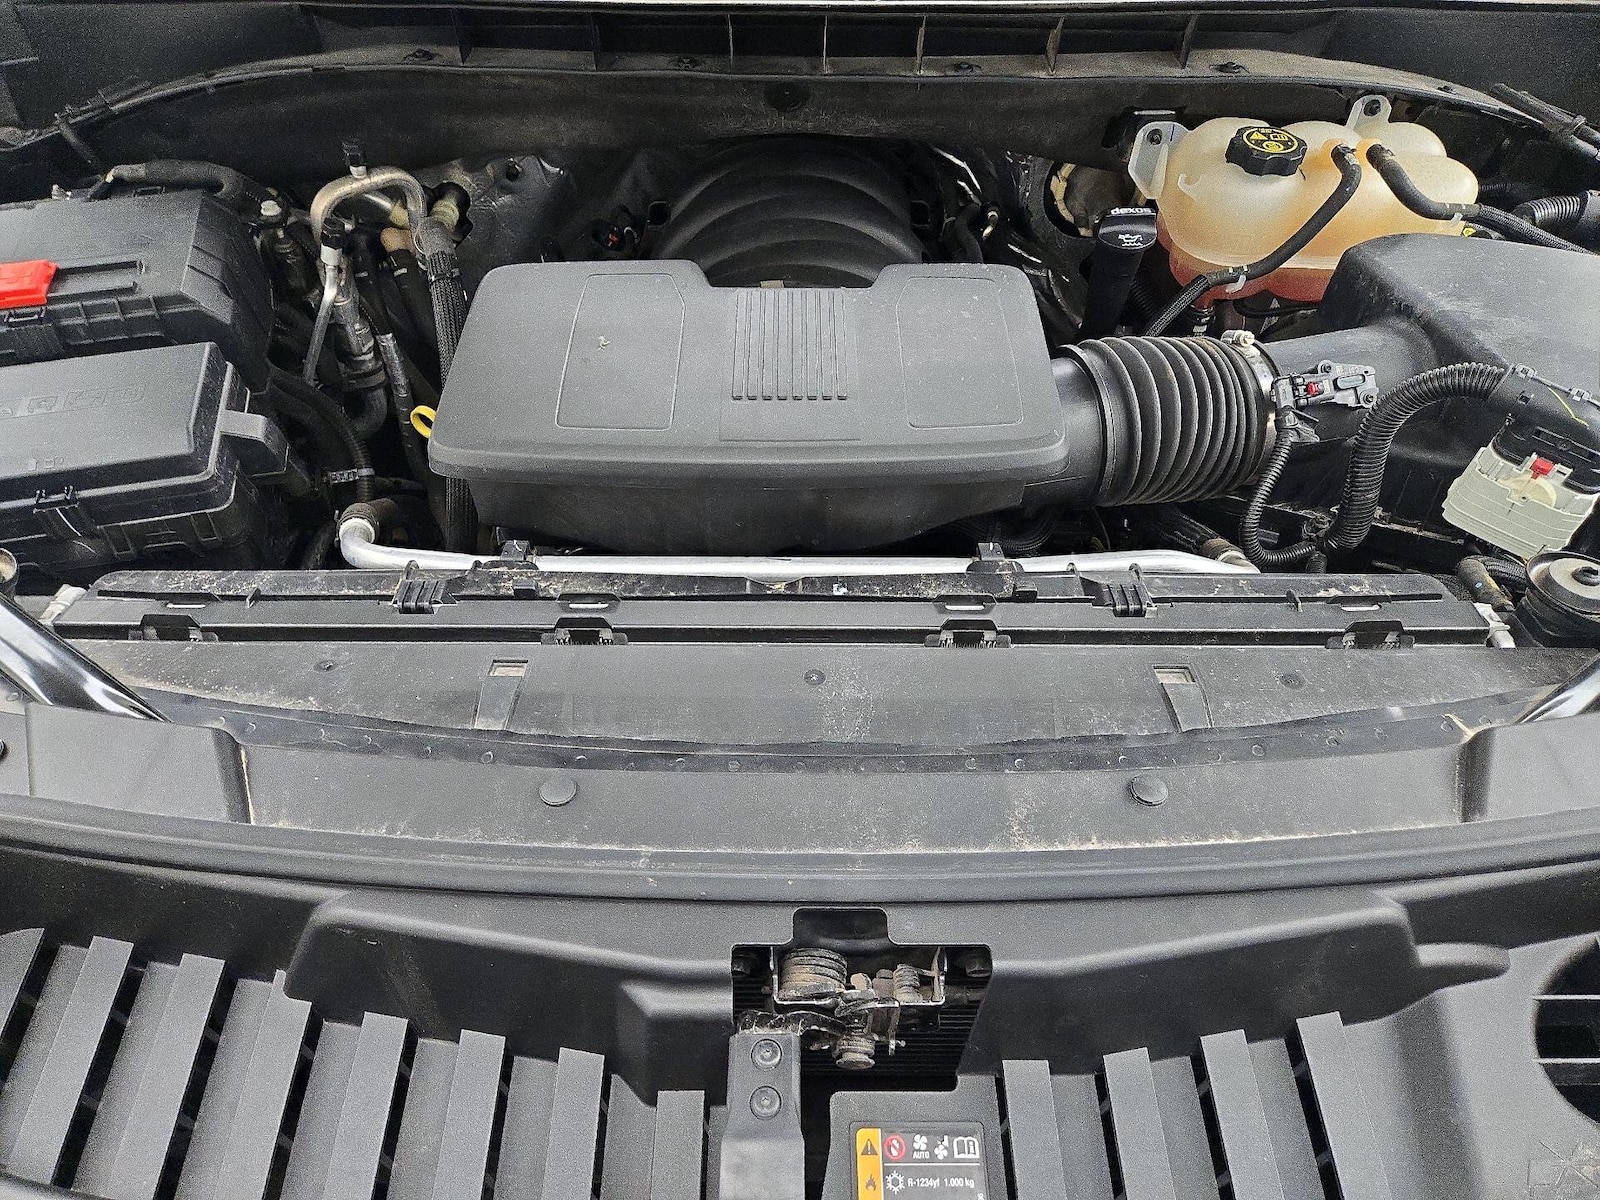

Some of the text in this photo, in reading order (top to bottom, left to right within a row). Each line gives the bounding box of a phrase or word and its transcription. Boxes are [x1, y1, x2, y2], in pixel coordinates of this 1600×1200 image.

[1110, 207, 1152, 215] dexos
[912, 1151, 930, 1159] AUTO
[907, 1178, 975, 1188] R-1234yf 1.000 kg
